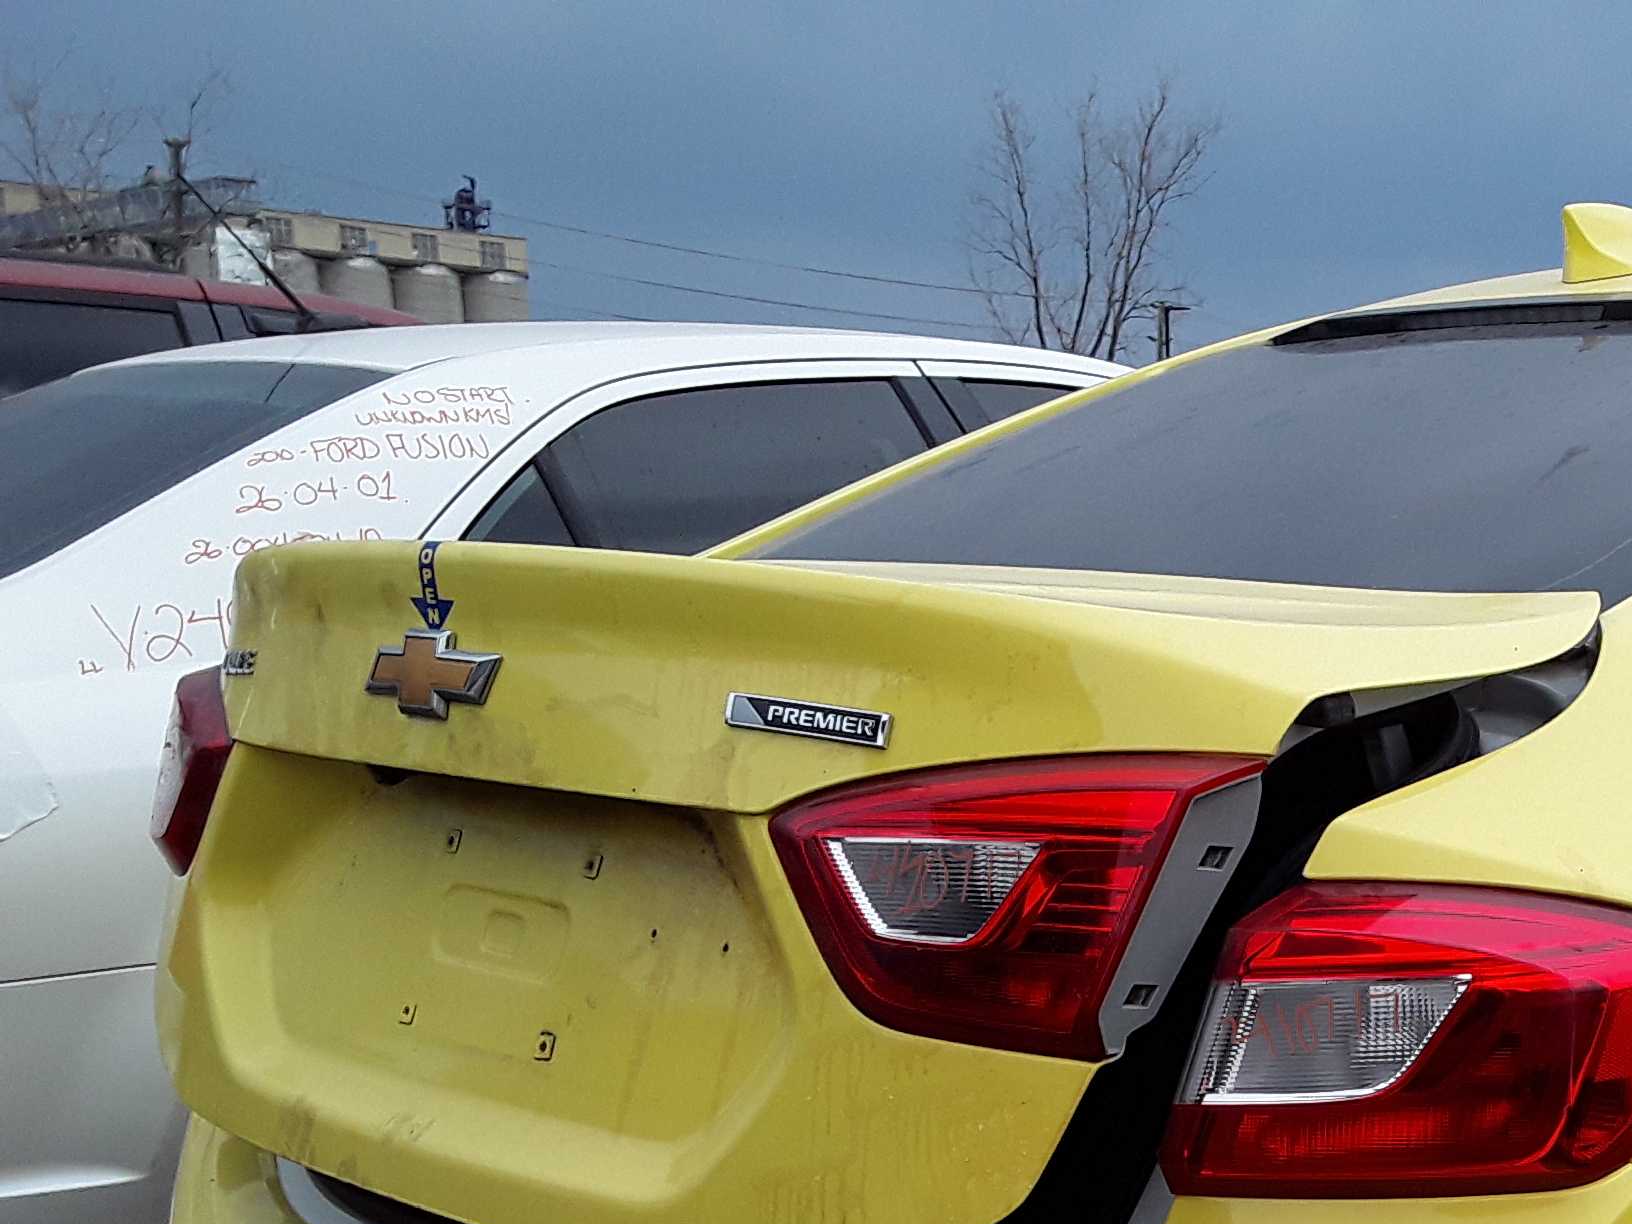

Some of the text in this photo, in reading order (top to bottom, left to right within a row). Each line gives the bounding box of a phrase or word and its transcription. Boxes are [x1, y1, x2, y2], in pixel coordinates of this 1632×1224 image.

[310, 436, 380, 463] FORD
[386, 433, 490, 459] FUSION
[421, 549, 441, 624] OPEN
[767, 704, 876, 736] PREMIER
